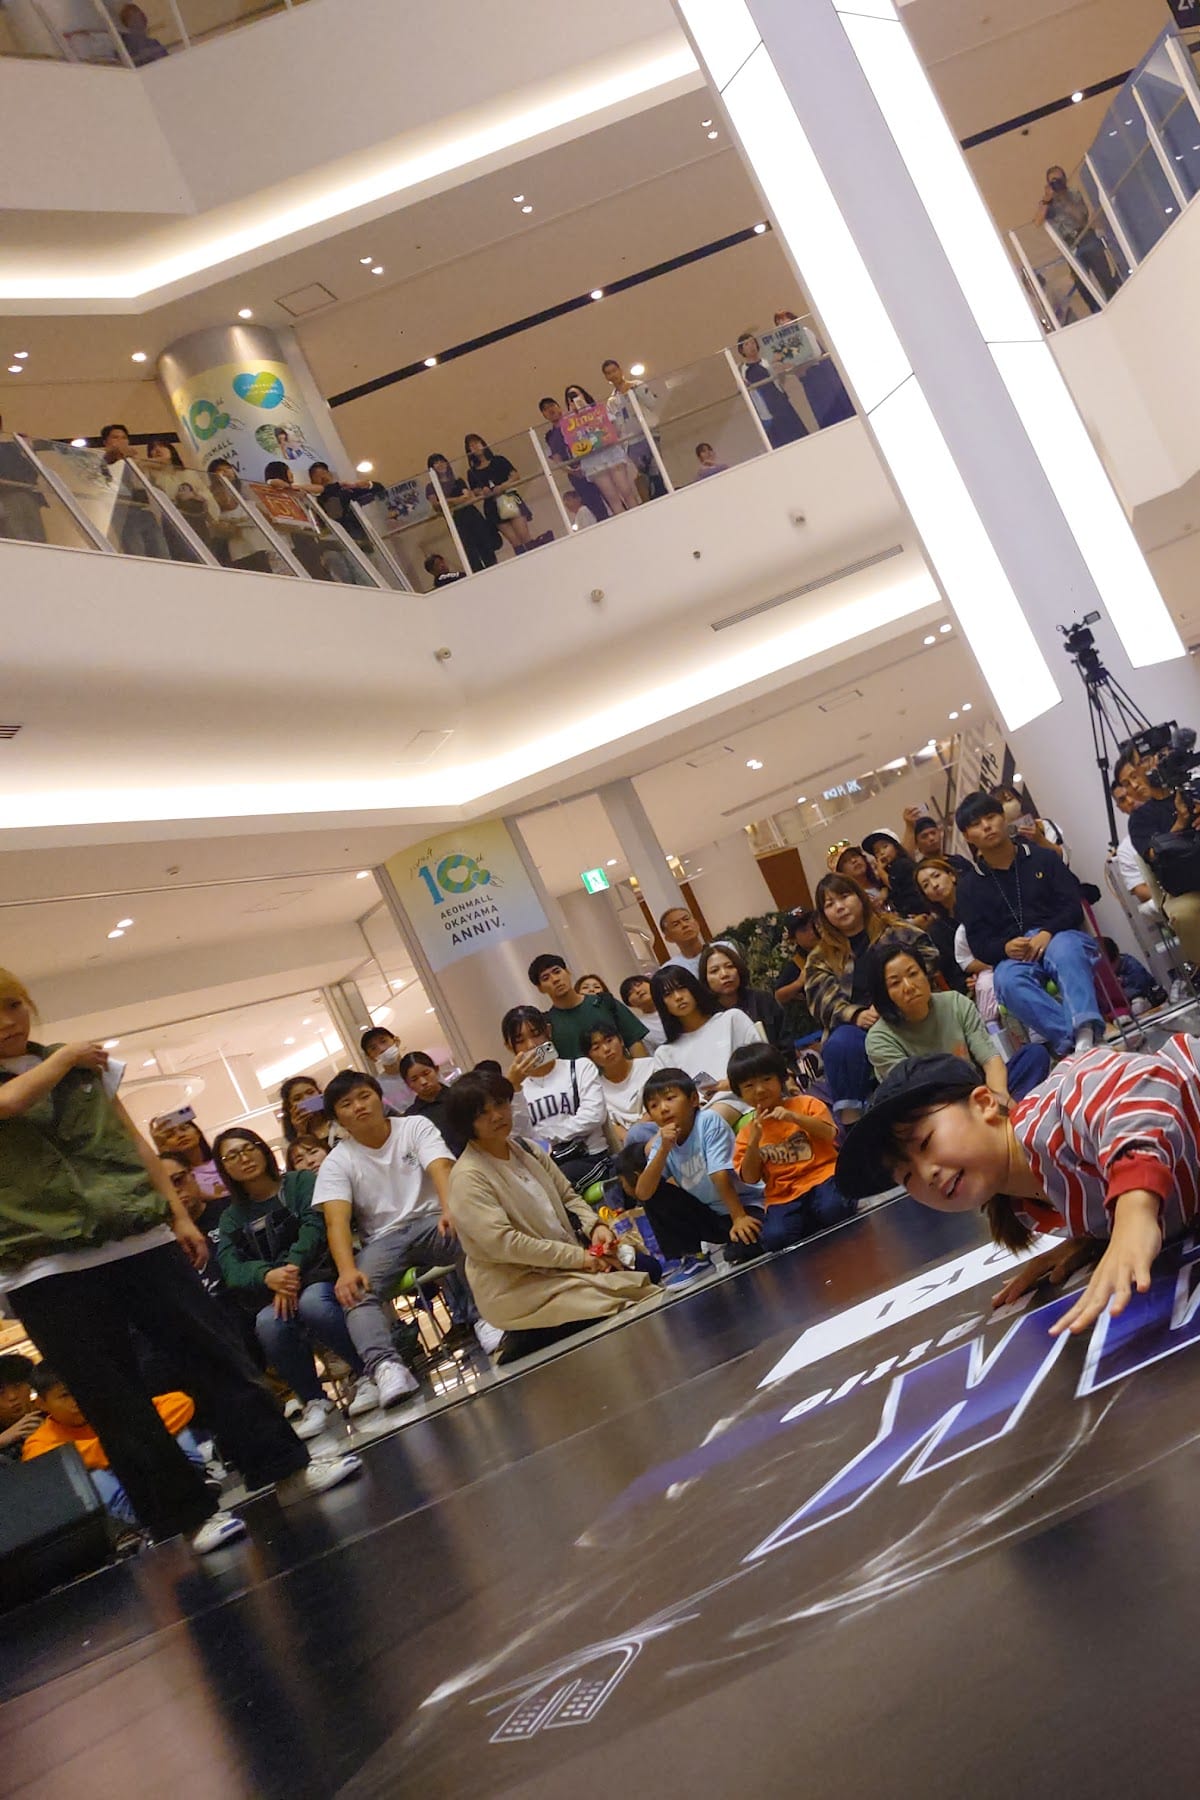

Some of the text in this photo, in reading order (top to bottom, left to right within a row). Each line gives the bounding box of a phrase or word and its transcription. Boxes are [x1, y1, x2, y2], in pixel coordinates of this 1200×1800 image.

[440, 894, 494, 920] AEONMALL
[444, 905, 499, 931] OKAYAMA
[451, 916, 507, 946] ANNIV.
[528, 1092, 577, 1127] IDA
[780, 1289, 1040, 1424] Battle
